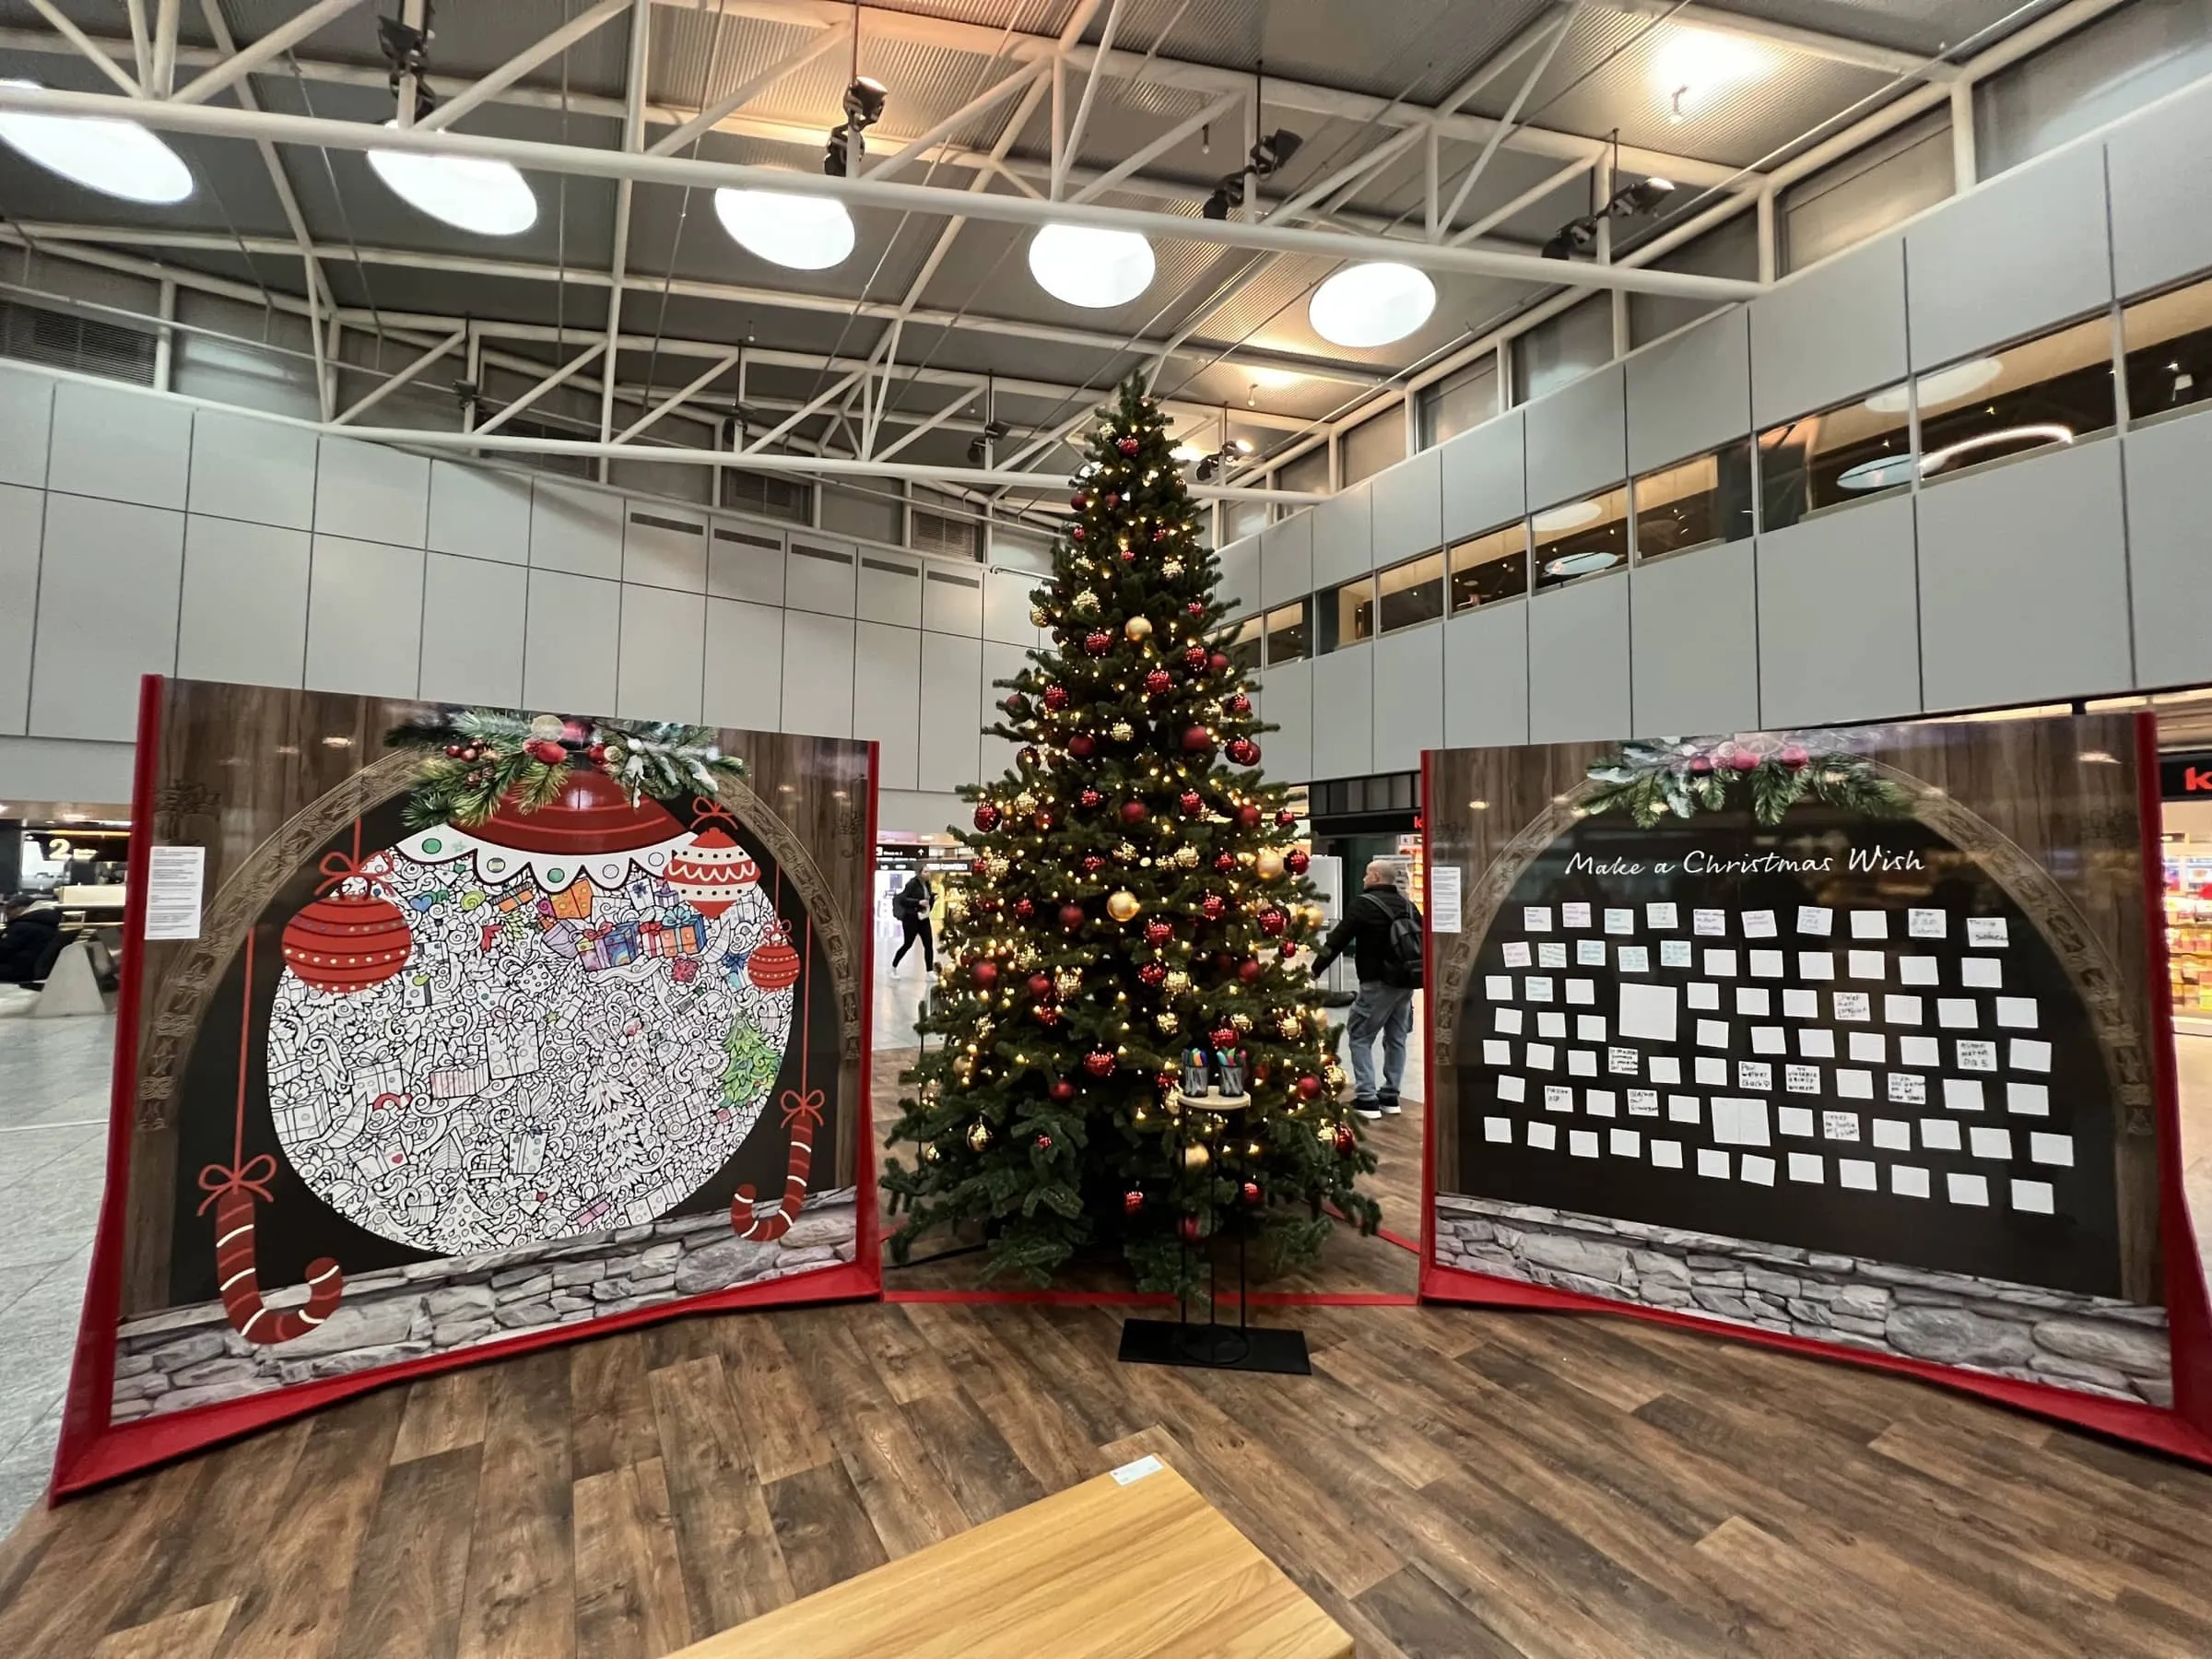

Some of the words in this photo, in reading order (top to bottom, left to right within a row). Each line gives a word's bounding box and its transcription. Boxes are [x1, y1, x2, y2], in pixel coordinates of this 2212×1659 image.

[49, 839, 72, 859] 2
[1565, 852, 1645, 875] Make
[1653, 862, 1676, 874] a
[1683, 850, 1833, 874] Christmas
[1848, 844, 1924, 872] Wish
